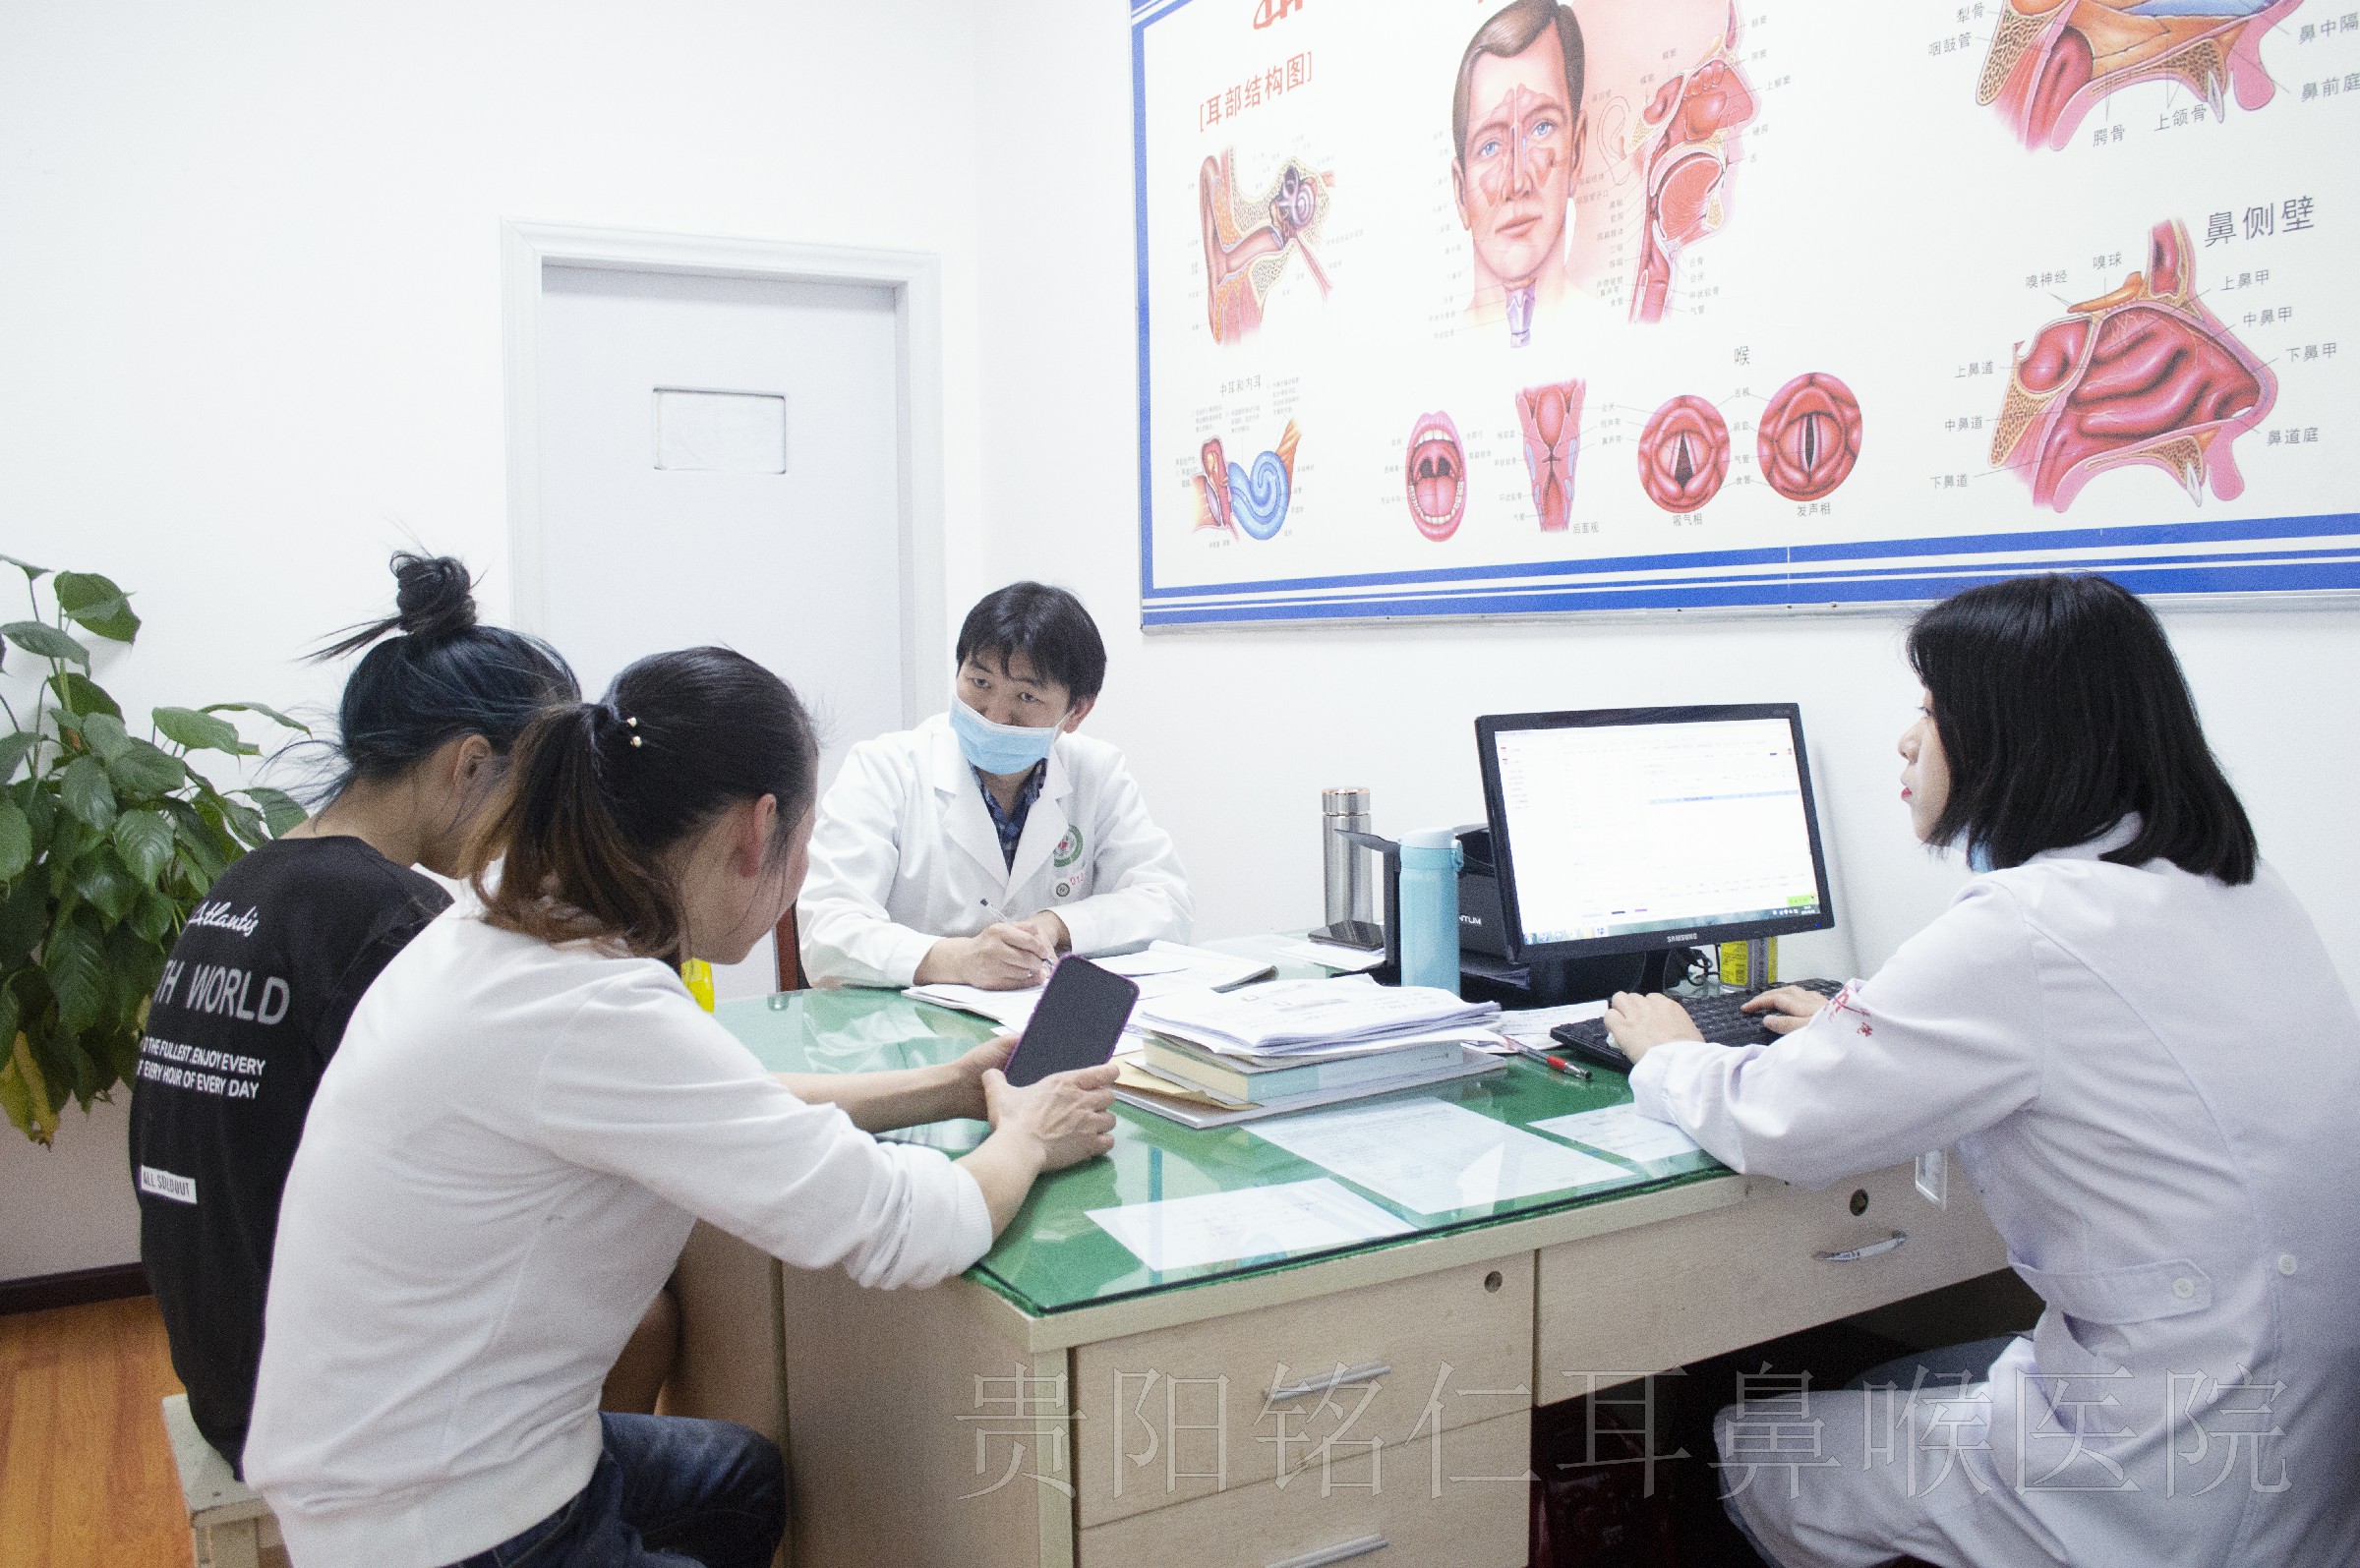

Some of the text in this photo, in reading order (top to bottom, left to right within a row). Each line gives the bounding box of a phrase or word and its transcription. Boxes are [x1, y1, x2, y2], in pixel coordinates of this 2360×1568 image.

[2298, 13, 2360, 44] 鼻中隔
[1928, 31, 1973, 57] 咽鼓管
[2301, 74, 2360, 103] 鼻前庭
[2154, 103, 2206, 132] 上颌骨
[2093, 124, 2125, 146] 腭骨
[2205, 196, 2315, 248] 鼻侧壁
[2094, 251, 2123, 270] 嗅球
[2026, 269, 2068, 289] 嗅神经
[2220, 268, 2271, 292] 上鼻甲
[2243, 307, 2293, 327] 中鼻甲
[1734, 345, 1750, 367] 喉
[2285, 342, 2338, 365] 下鼻甲
[1954, 361, 1995, 379] 上鼻道
[1944, 415, 1983, 433] 中鼻道
[2267, 427, 2320, 447] 鼻道庭
[1930, 474, 1969, 490] 下鼻道
[1797, 502, 1831, 517] 发声相
[1667, 933, 1697, 943] SAMSUNG
[186, 963, 290, 1025] WORLD
[221, 1053, 266, 1075] EVERY
[183, 1071, 197, 1088] OF
[198, 1073, 227, 1095] EVERY
[228, 1079, 260, 1099] DAY
